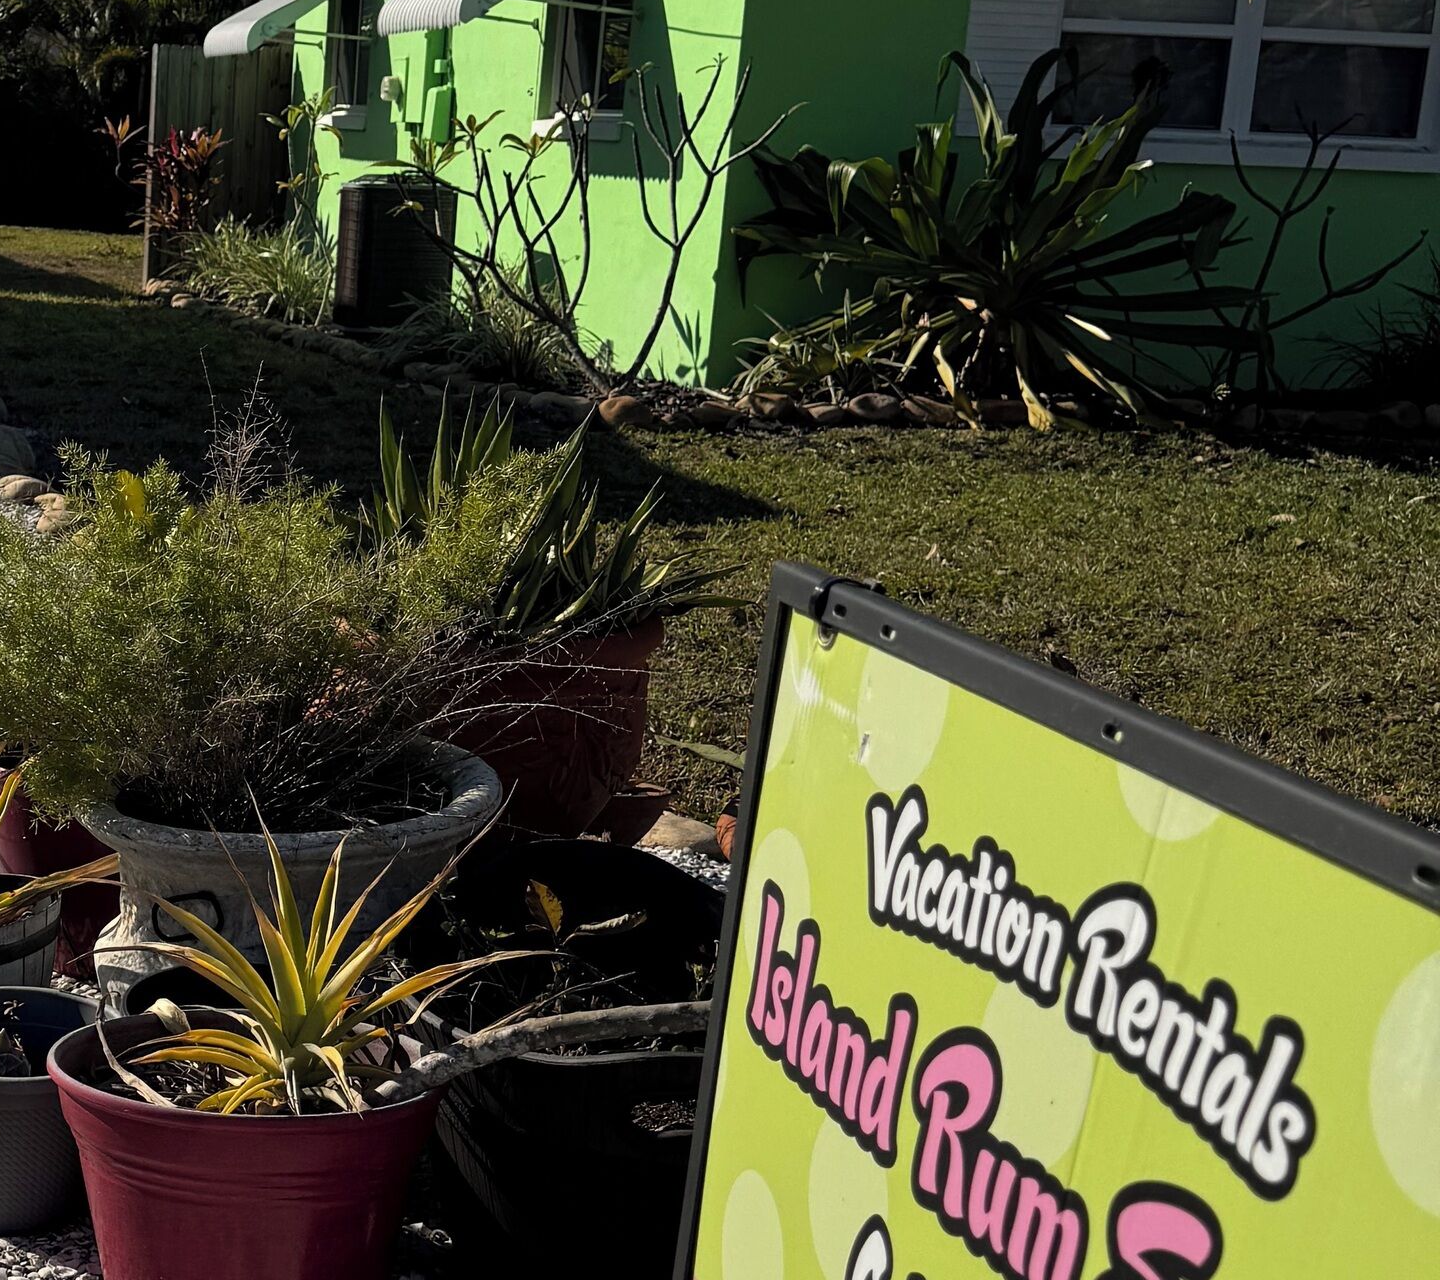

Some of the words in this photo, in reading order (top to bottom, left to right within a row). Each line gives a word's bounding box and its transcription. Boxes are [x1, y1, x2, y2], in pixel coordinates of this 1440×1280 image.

[748, 880, 917, 1166] Island
[867, 786, 1071, 1006] Vacation
[1067, 883, 1315, 1199] Rentals
